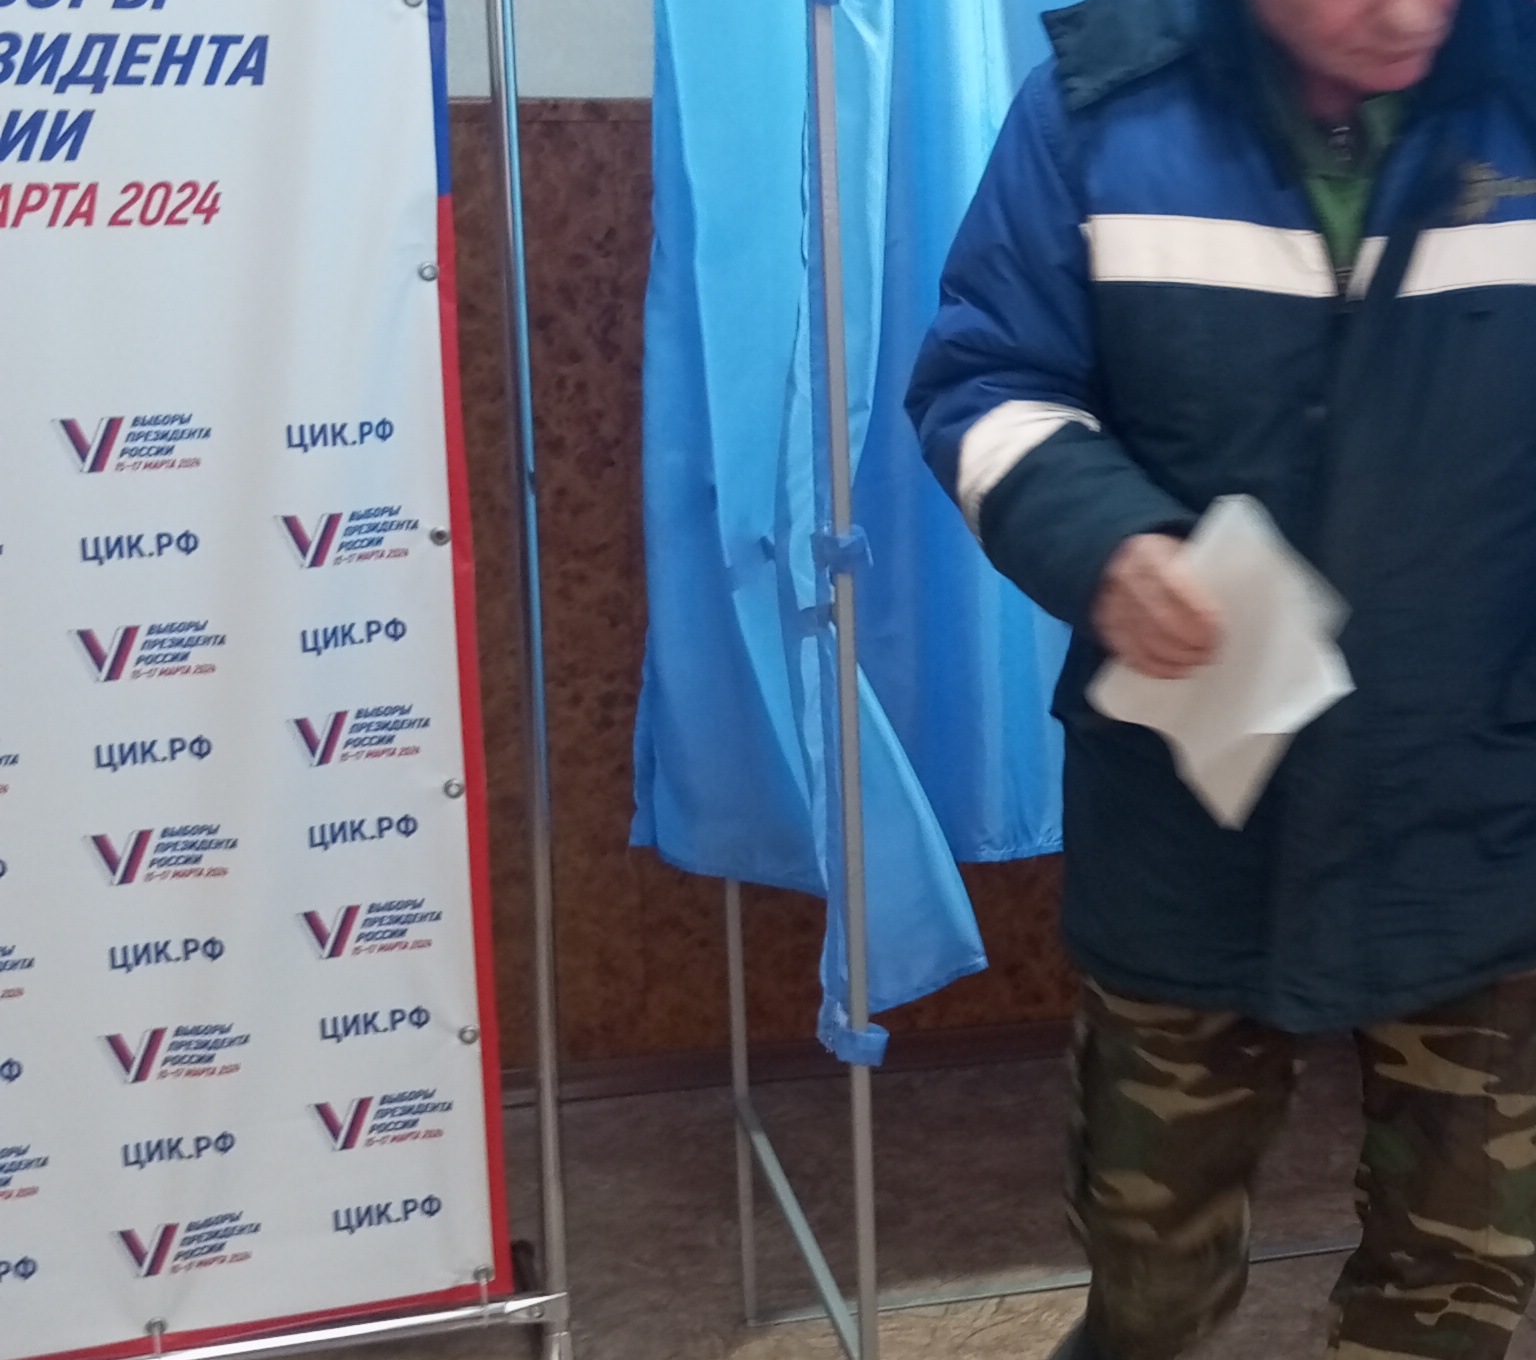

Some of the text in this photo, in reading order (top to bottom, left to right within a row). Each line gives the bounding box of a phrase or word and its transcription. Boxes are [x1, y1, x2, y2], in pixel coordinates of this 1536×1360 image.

[107, 180, 222, 227] 2024
[131, 413, 193, 427] ВЫБОРЫ
[286, 417, 395, 454] ЦИК.РФ
[119, 444, 175, 459] РОССИИ
[80, 529, 200, 567] ЦИК.РФ
[300, 617, 407, 657] ЦИК.РФ
[94, 734, 213, 773] ЦИК.РФ
[308, 813, 419, 851] ЦИК.РФ
[108, 936, 225, 974] ЦИК.РФ
[319, 1005, 431, 1044] ЦИК.РФ
[121, 1130, 236, 1170] ЦИК.РФ
[332, 1194, 443, 1235] ЦИК.РФ
